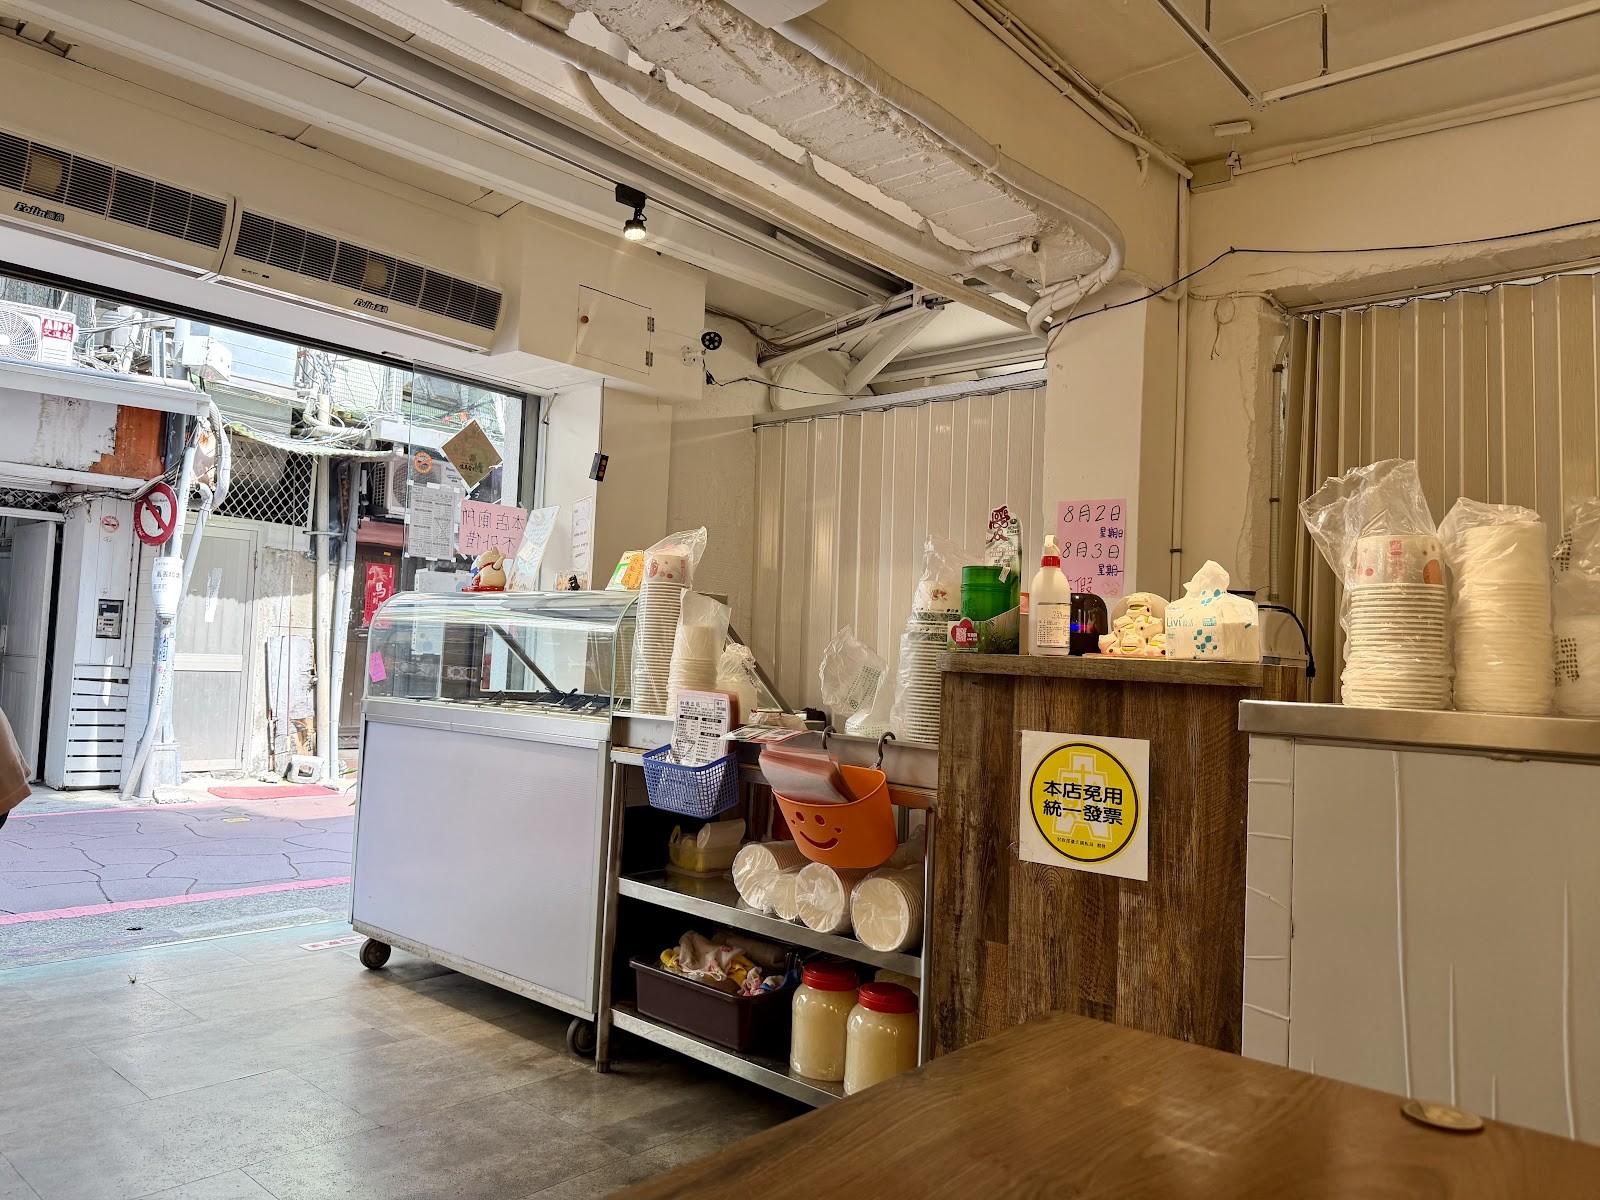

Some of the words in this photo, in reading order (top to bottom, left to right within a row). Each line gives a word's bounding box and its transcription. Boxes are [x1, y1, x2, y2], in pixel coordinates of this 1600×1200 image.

[1063, 504, 1121, 523] 8月2日
[1099, 526, 1124, 539] 星期日
[1062, 541, 1120, 559] 8月3日
[1097, 563, 1124, 577] 星期一
[1043, 780, 1123, 806] 本店免用
[1043, 799, 1123, 825] 統一發票
